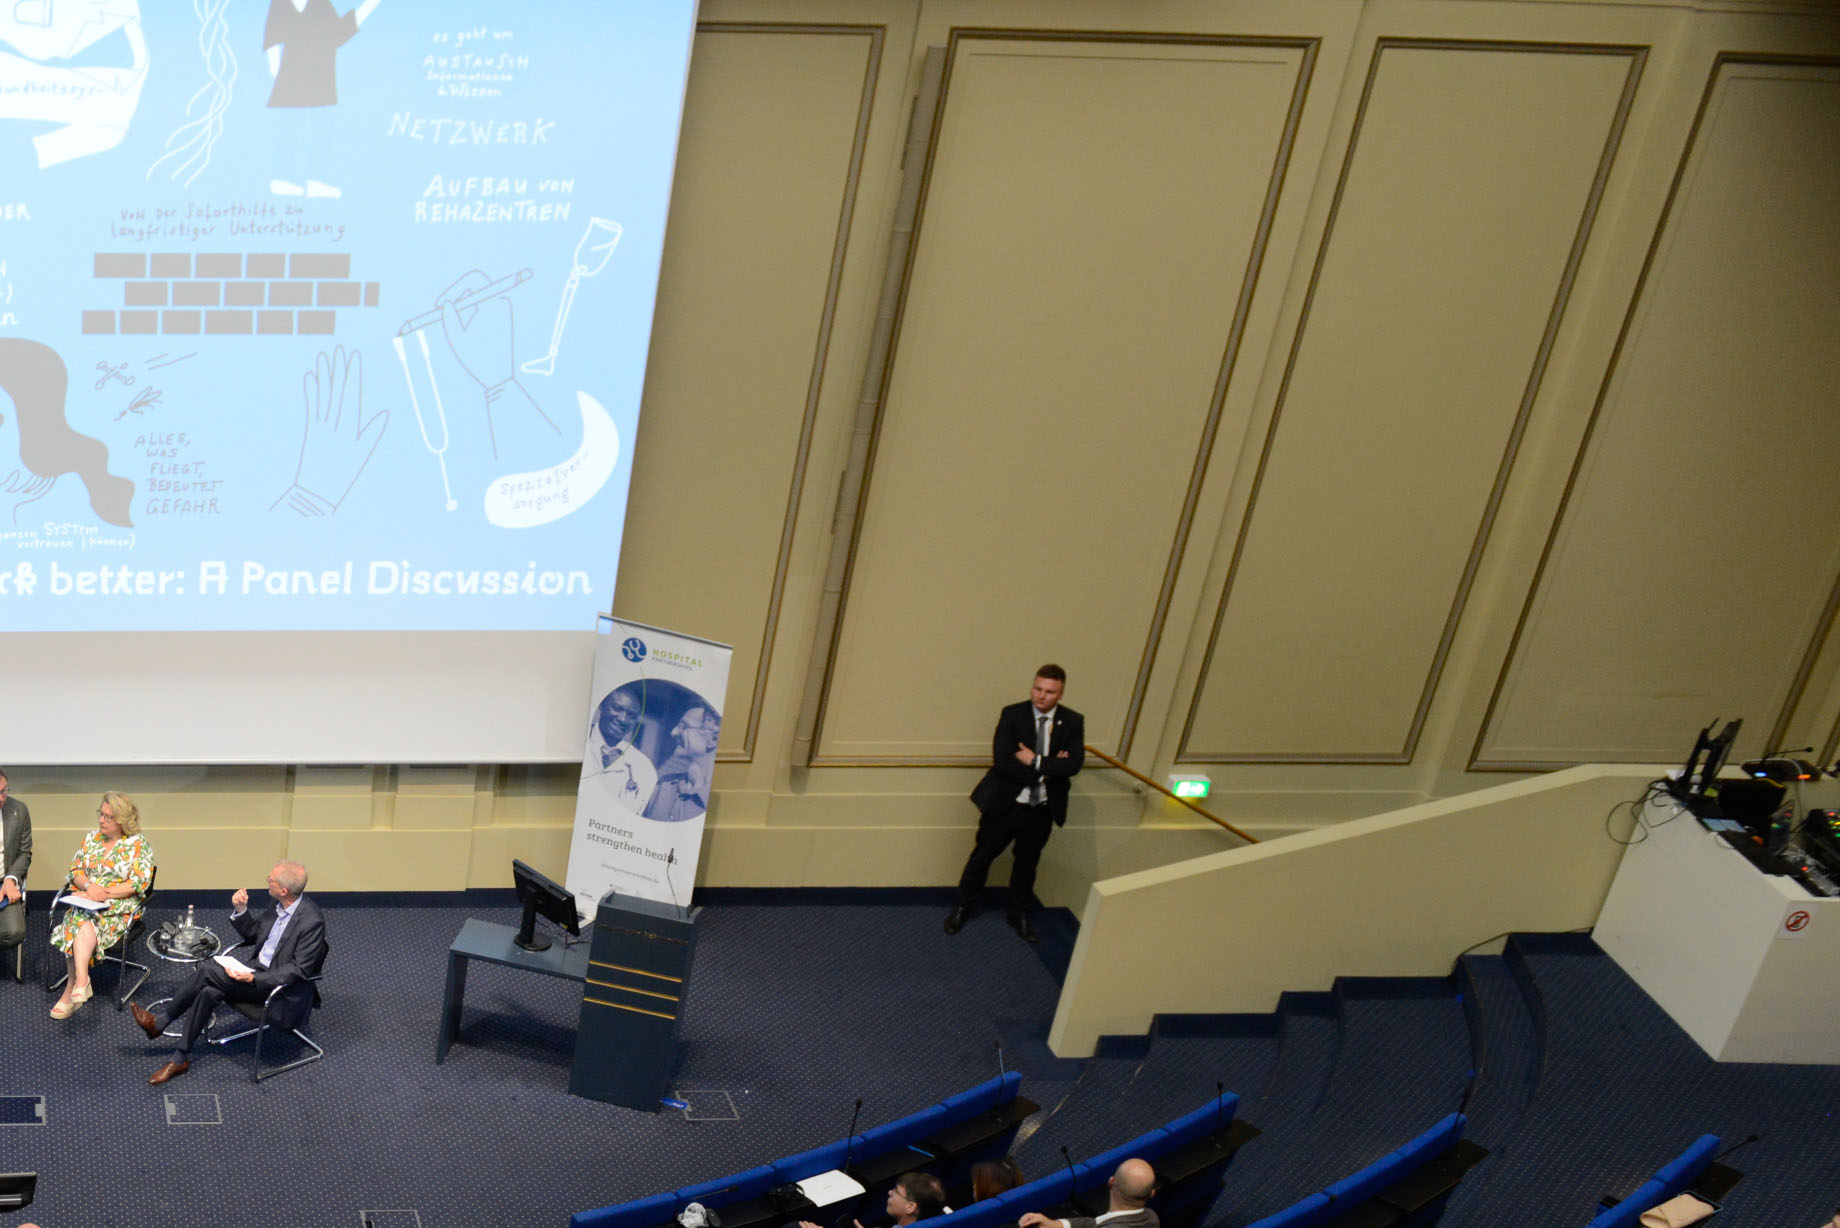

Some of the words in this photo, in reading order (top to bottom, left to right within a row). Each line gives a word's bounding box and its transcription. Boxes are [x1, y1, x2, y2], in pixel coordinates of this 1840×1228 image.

[432, 32, 448, 43] es
[455, 24, 488, 48] geht
[493, 30, 514, 41] um
[387, 111, 557, 145] NETZWERK
[423, 174, 528, 198] AUFBAU
[185, 201, 277, 221] Soforthilfe
[414, 200, 572, 224] REHAZENTREN
[229, 216, 347, 243] Unterstützung
[133, 431, 192, 448] ALLES,
[146, 448, 179, 458] WAS
[147, 477, 225, 493] BEDEUTET
[146, 497, 222, 515] GEFAHR
[51, 561, 185, 596] better:
[197, 561, 228, 596] A
[242, 561, 354, 596] Panel
[367, 560, 593, 596] Discussion
[653, 648, 703, 667] HOSPITAL
[588, 818, 634, 839] Partners
[586, 833, 643, 855] strengthen
[644, 848, 678, 865] healh
